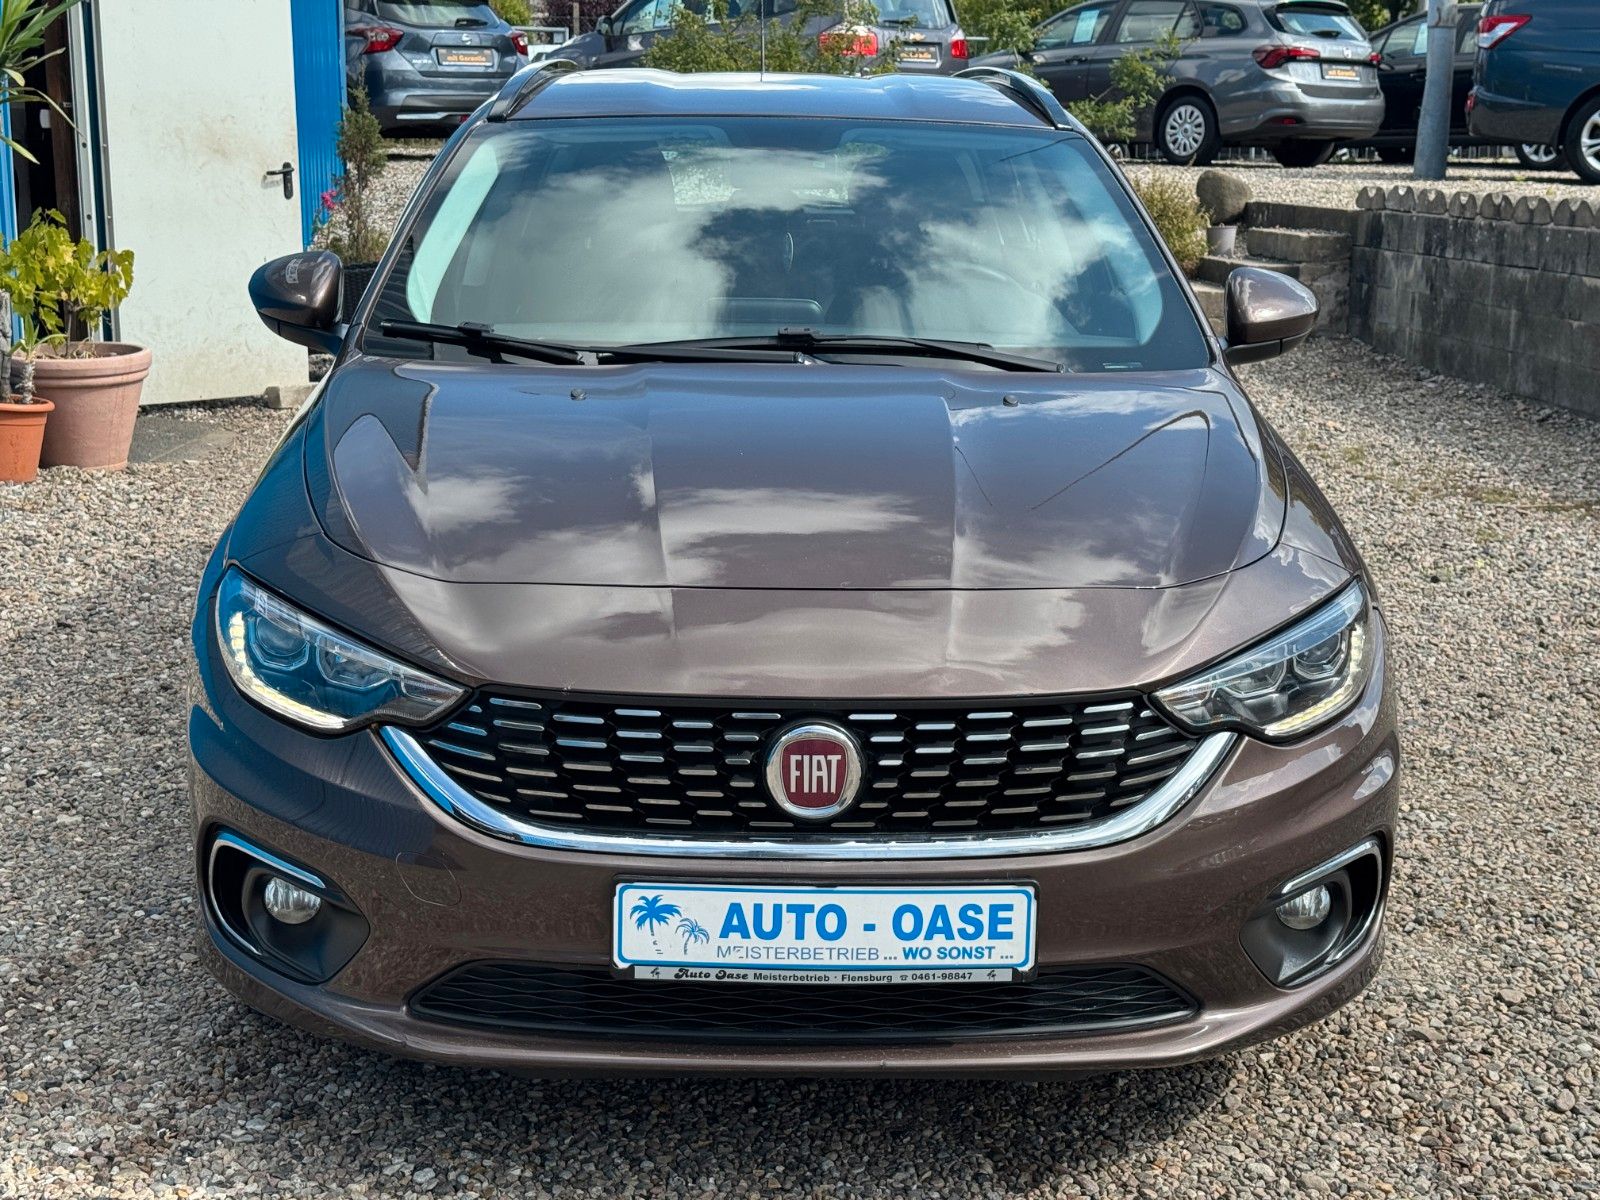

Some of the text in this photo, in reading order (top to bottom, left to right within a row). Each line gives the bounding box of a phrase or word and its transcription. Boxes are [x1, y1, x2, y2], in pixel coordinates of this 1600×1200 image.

[789, 754, 842, 794] FIAT
[719, 903, 847, 942] AUTO
[892, 903, 1014, 941] OASE
[902, 947, 932, 960] WO
[937, 946, 996, 960] SONST
[674, 967, 711, 980] Auto
[715, 969, 749, 980] Oase
[753, 971, 830, 983] Meisterbetrieb
[841, 973, 893, 984] Flensburg
[911, 972, 973, 981] 0461-98847
